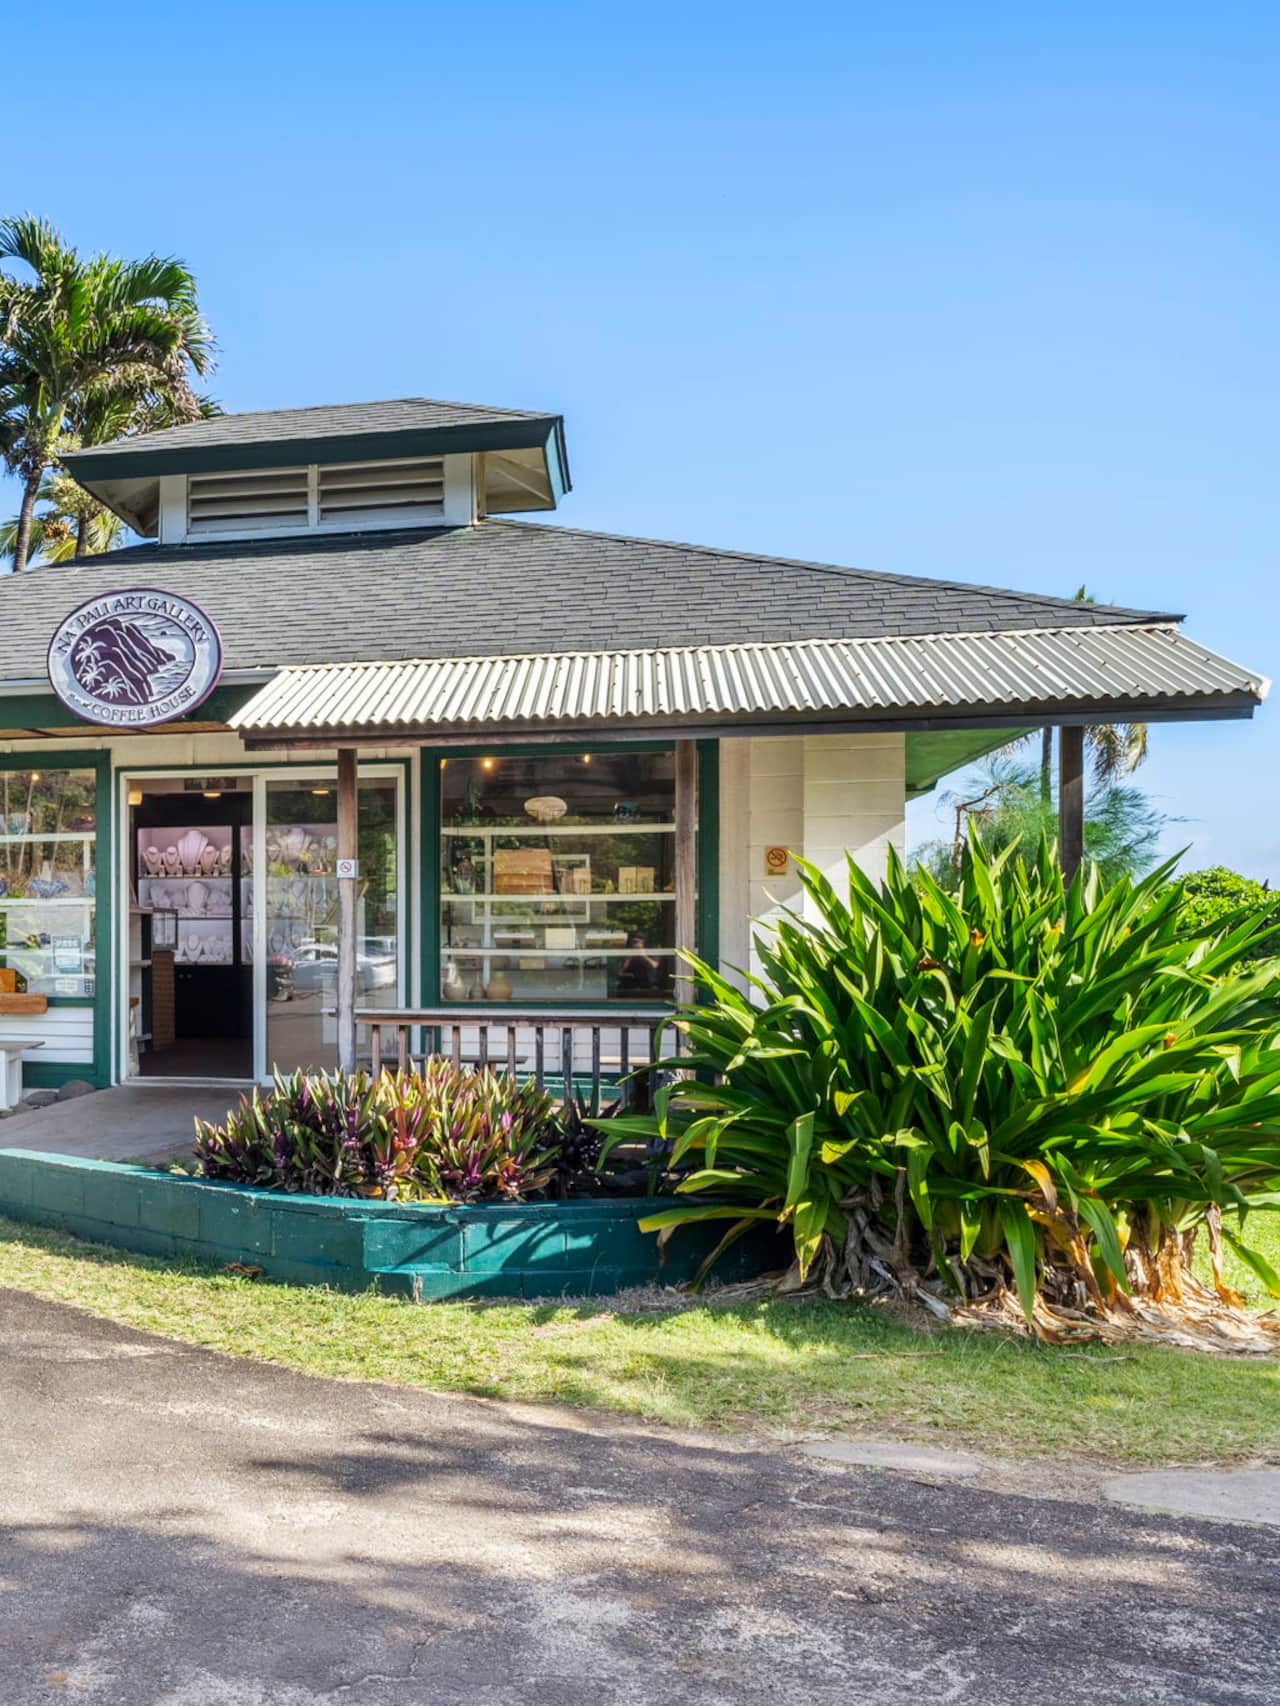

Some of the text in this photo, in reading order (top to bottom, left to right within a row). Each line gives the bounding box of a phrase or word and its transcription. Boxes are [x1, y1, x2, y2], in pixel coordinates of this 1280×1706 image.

[77, 602, 110, 628] PALI
[114, 596, 146, 612] ART
[147, 598, 209, 643] GALLERY
[92, 685, 197, 721] COFFEE HOUSE
